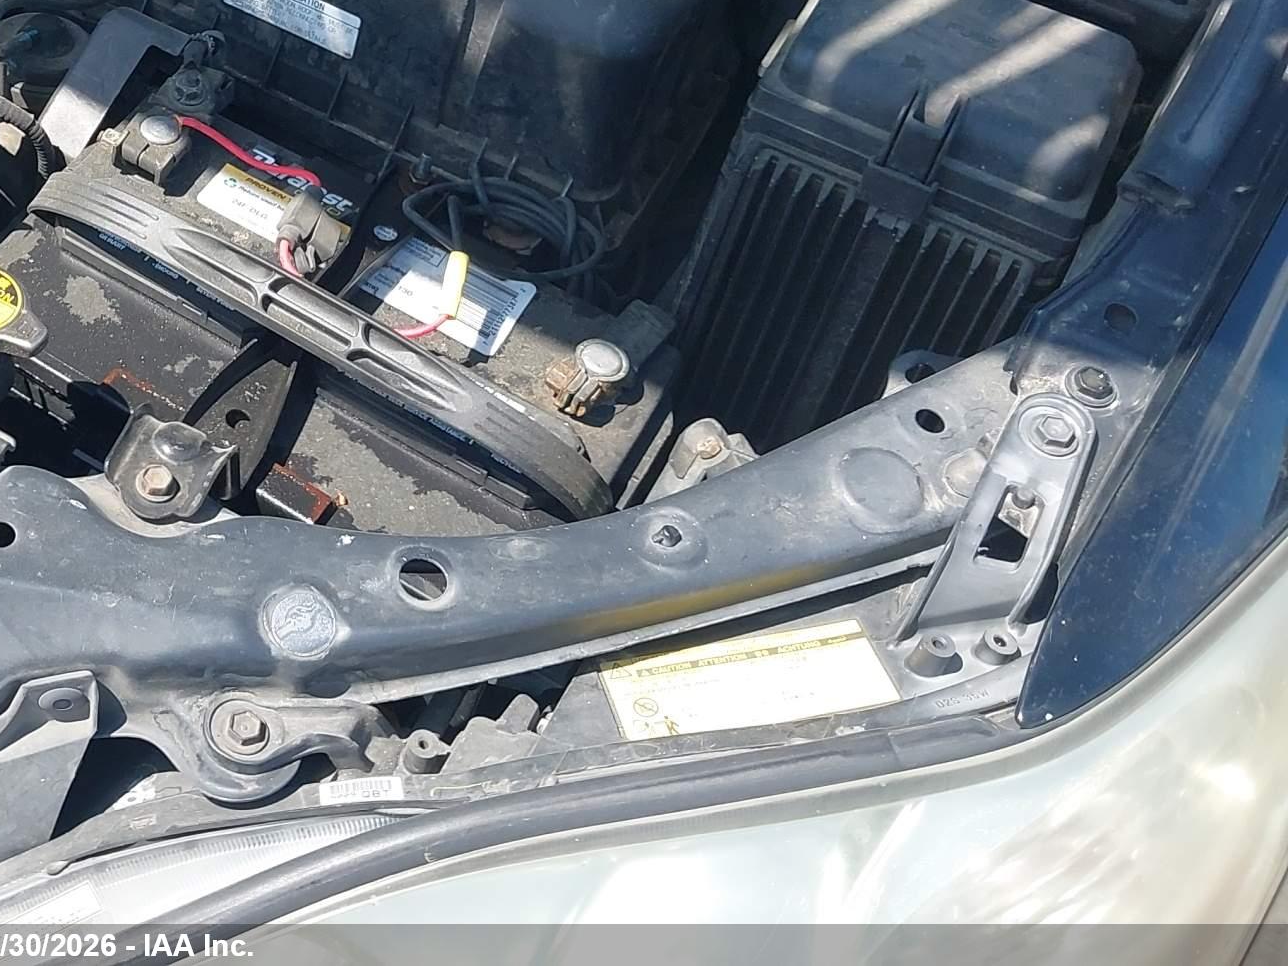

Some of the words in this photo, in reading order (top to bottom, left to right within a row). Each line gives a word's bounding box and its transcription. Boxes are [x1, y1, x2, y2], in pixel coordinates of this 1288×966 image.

[245, 176, 287, 200] PROVEN
[653, 660, 692, 674] CAUTION
[697, 651, 748, 667] ATTENTION
[777, 640, 821, 654] ACHTUNG
